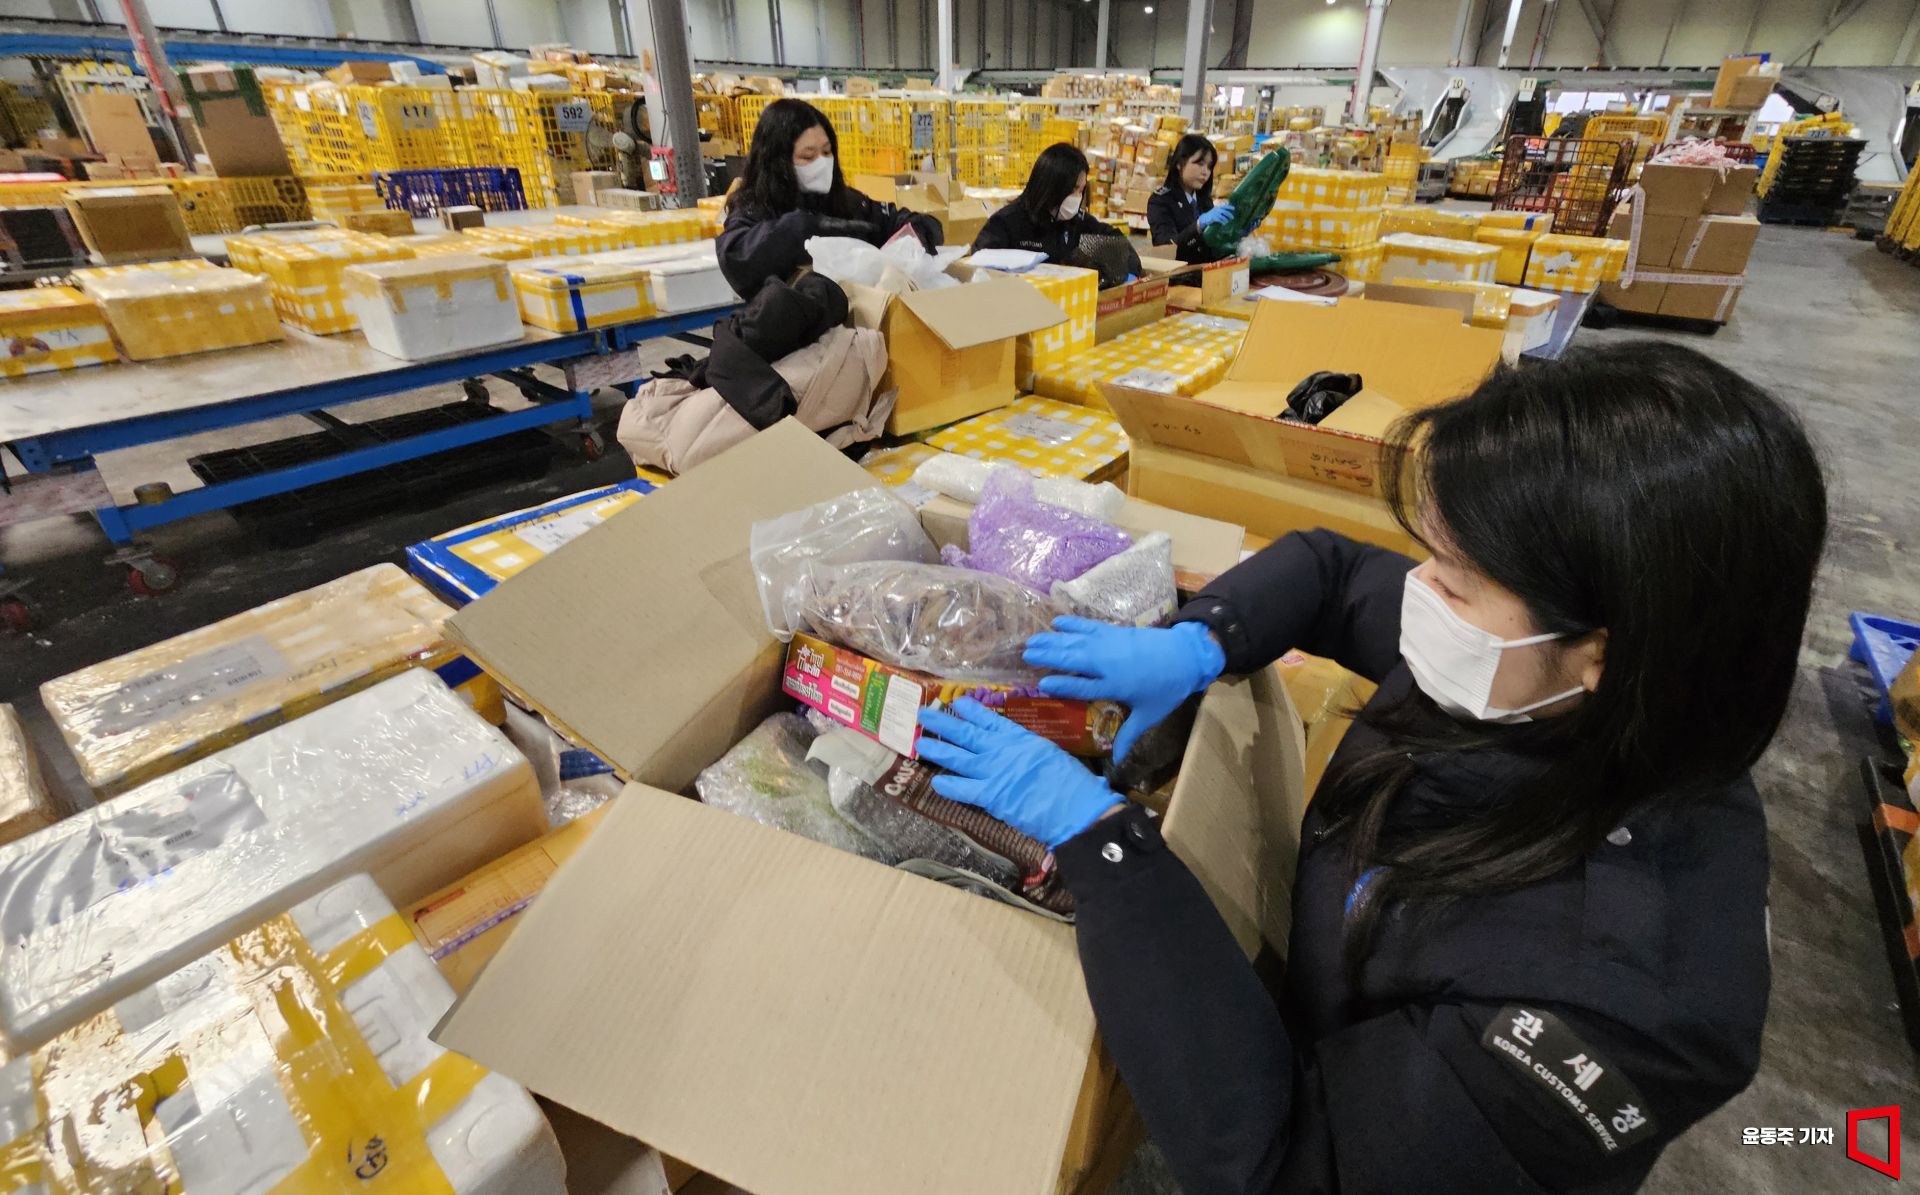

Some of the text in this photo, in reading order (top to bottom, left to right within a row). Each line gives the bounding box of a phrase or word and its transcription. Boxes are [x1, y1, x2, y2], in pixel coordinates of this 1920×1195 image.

[1453, 79, 1464, 89] 10
[1524, 79, 1534, 89] 11
[562, 105, 583, 120] 592
[918, 113, 933, 127] 272
[1493, 1035, 1618, 1151] KOREA CUSTOMS SERVICE
